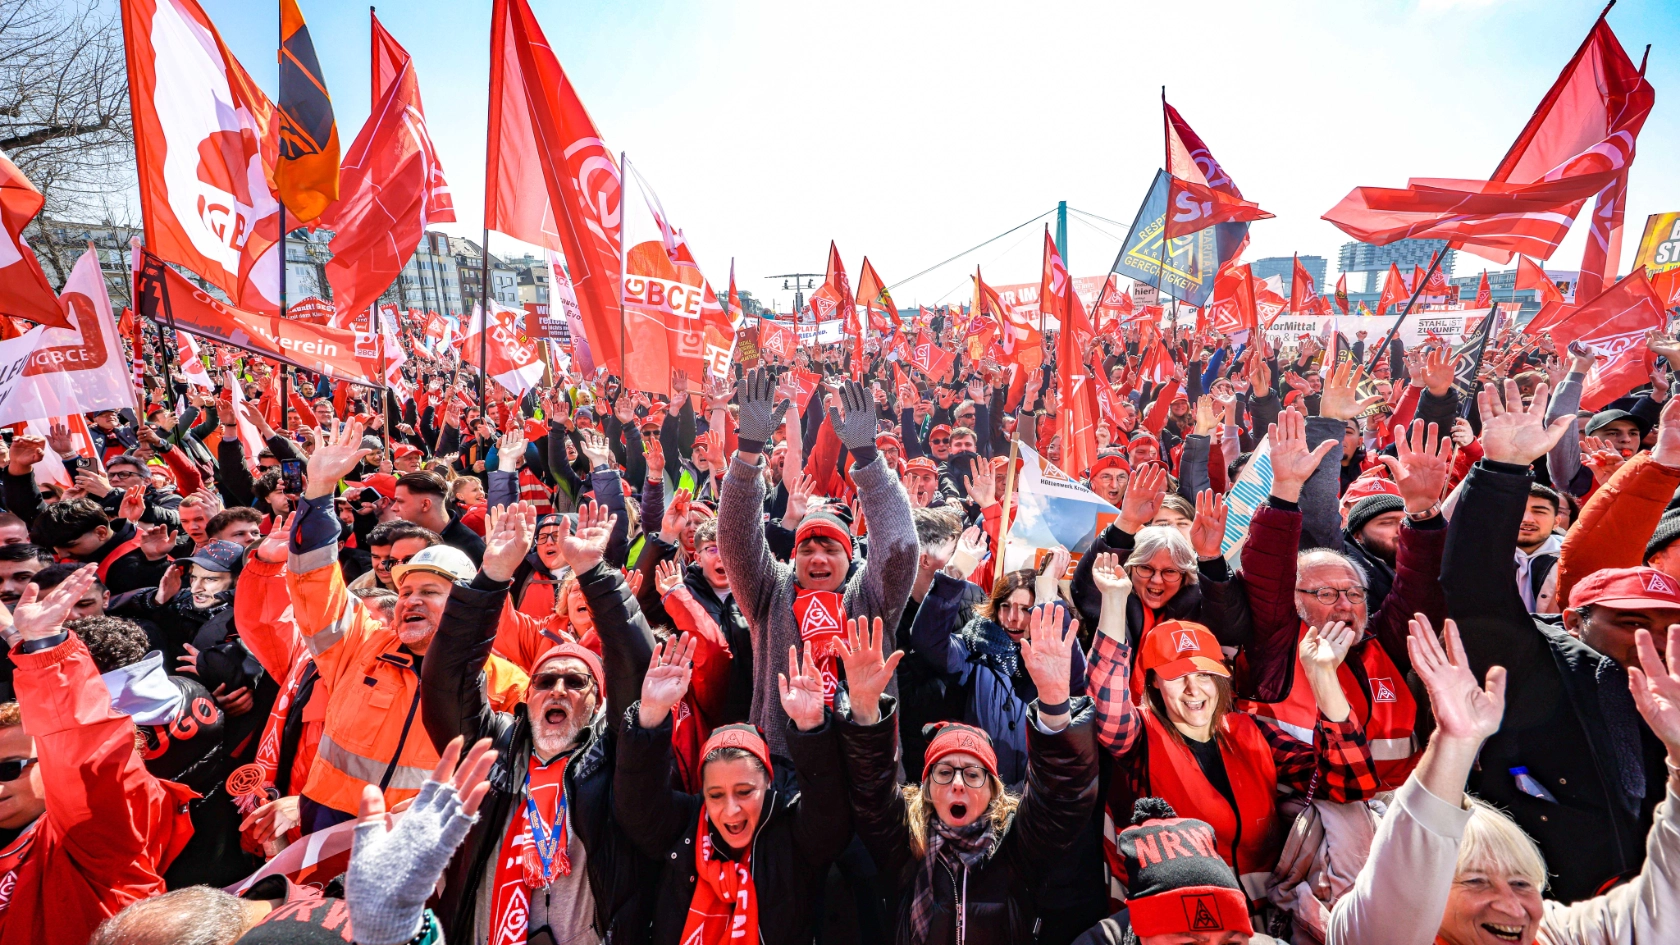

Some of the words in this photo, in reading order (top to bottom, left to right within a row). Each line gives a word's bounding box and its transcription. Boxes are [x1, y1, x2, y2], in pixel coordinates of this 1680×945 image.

[197, 194, 246, 252] IGB
[1656, 242, 1680, 263] ST
[624, 278, 701, 314] IGBCE
[1135, 288, 1154, 296] hier!
[1417, 326, 1461, 334] ZUKUNFT
[1419, 319, 1447, 327] STAHL
[1449, 319, 1462, 327] IST
[492, 326, 531, 364] DGB
[31, 349, 89, 367] IGBCE
[1134, 826, 1219, 869] NRW
